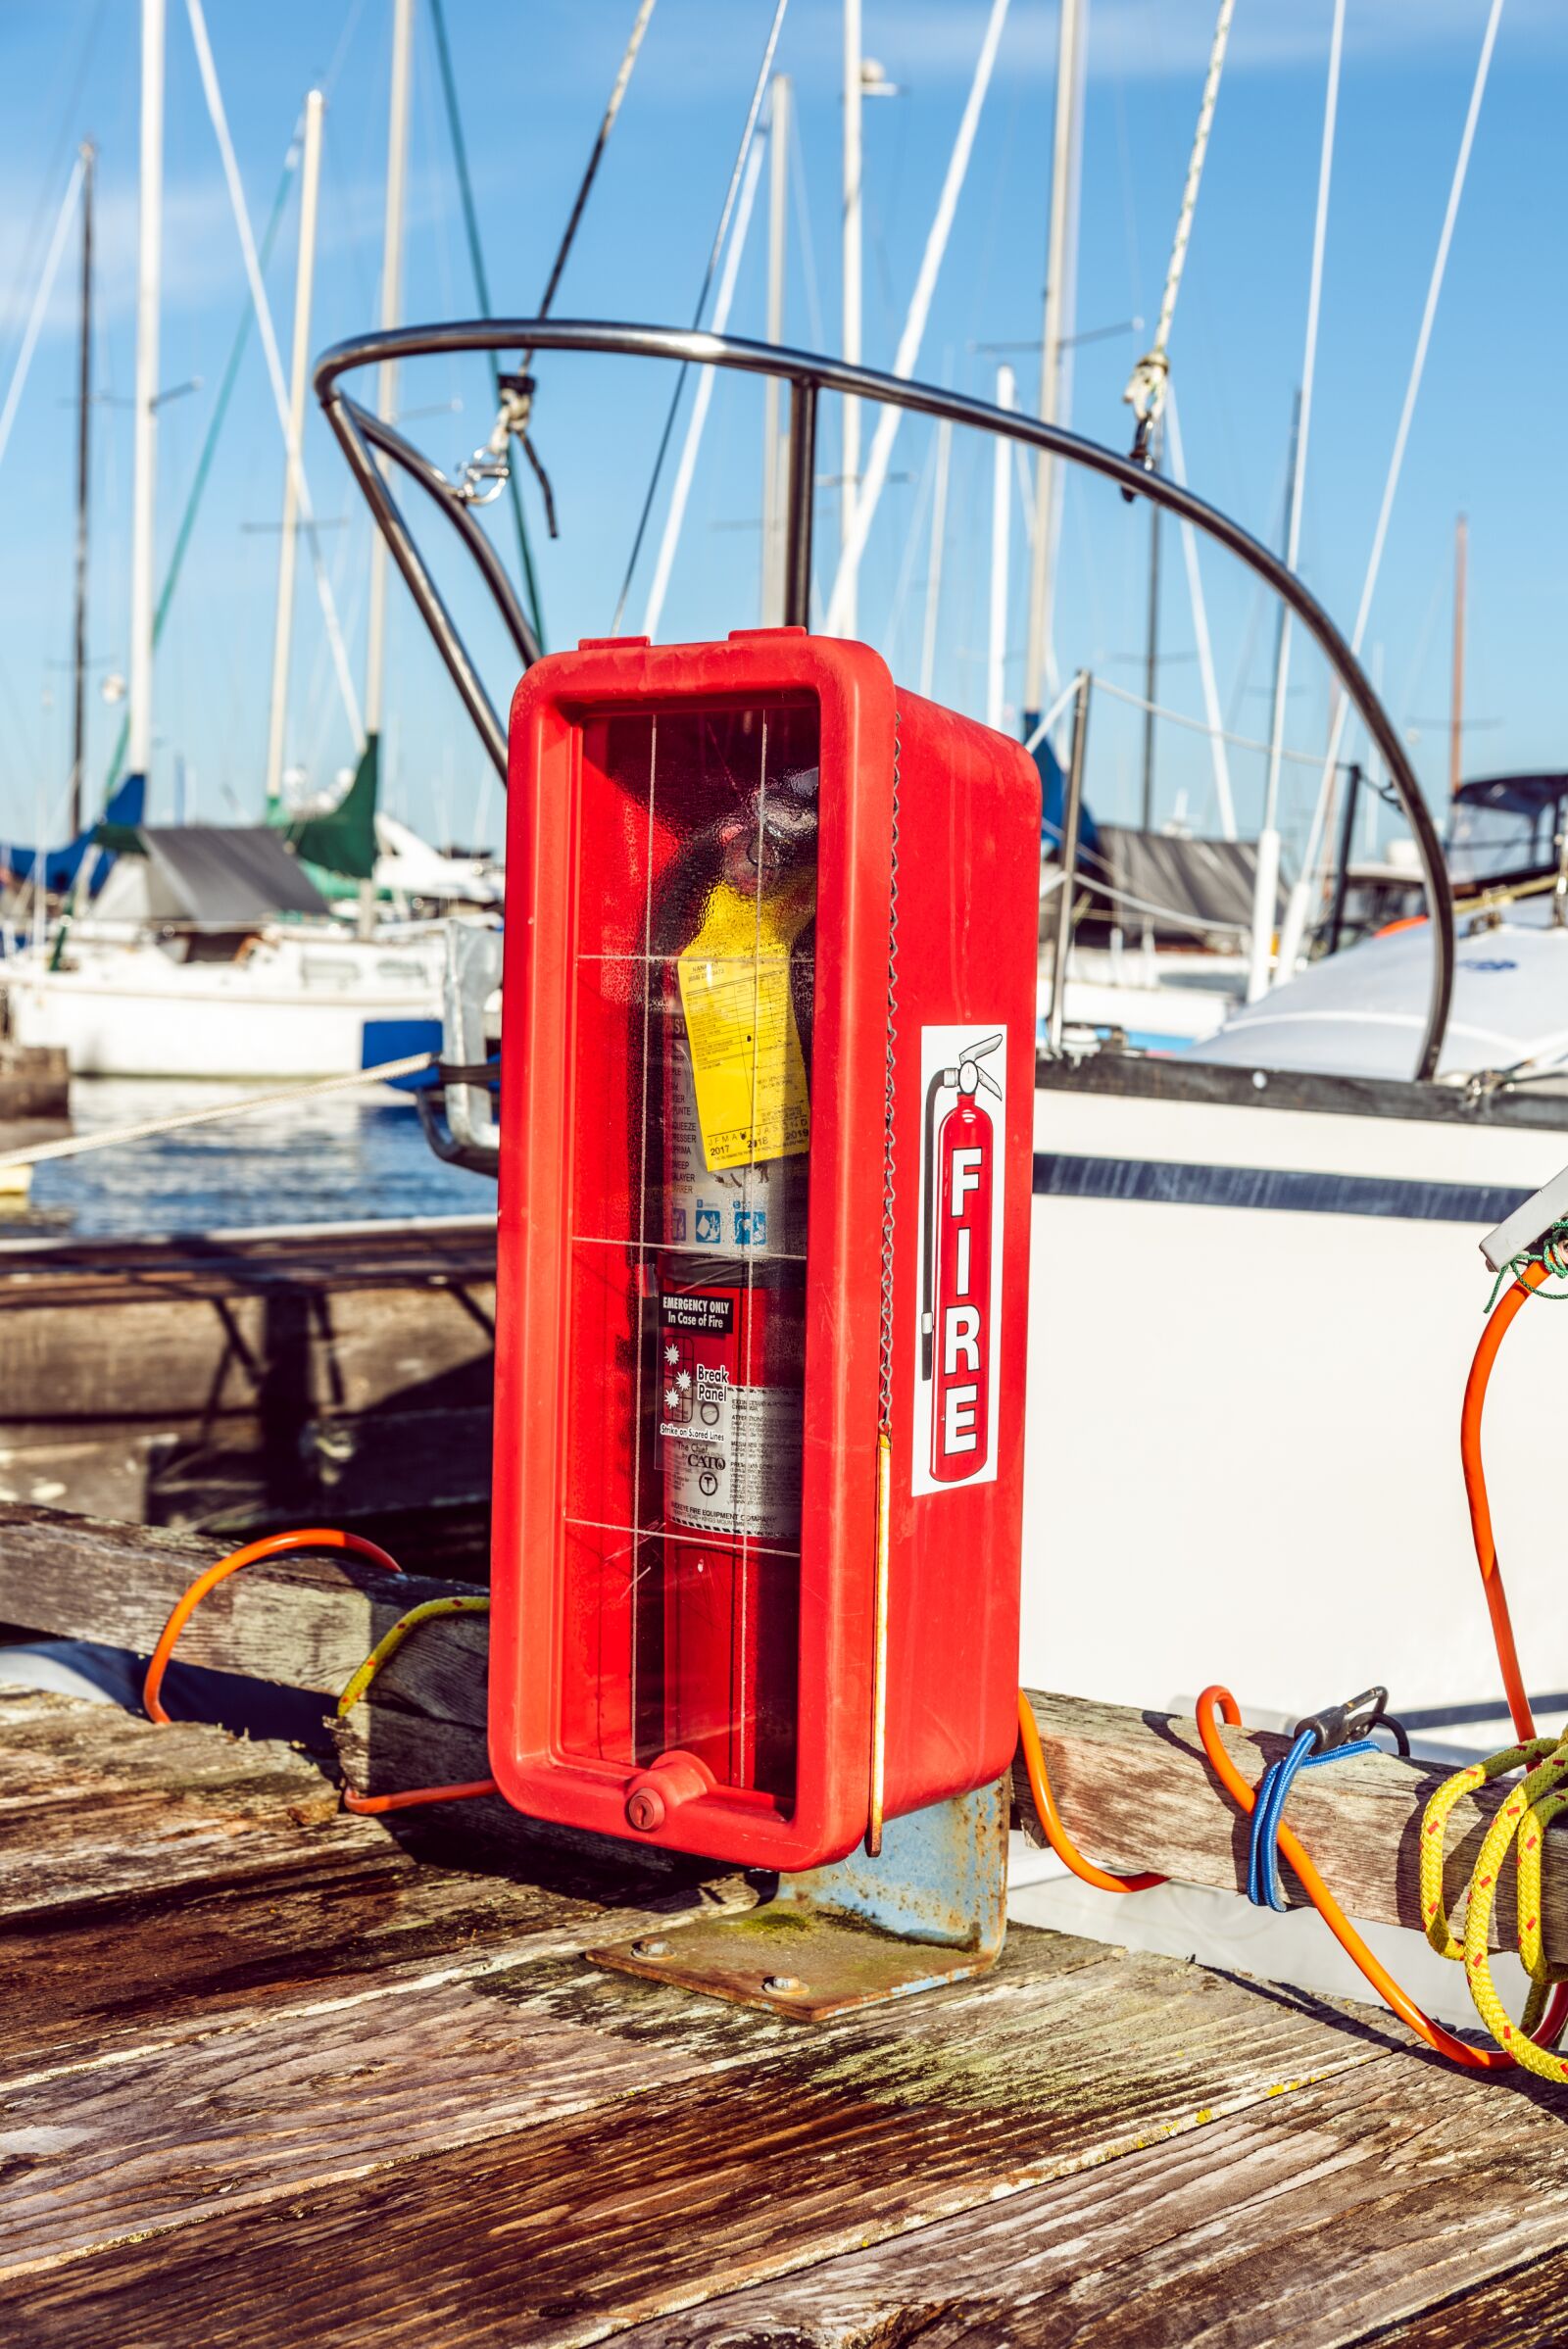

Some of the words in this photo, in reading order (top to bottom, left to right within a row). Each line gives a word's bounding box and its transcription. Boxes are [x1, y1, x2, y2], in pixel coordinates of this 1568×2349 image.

[710, 1145, 730, 1156] 2017
[662, 1297, 709, 1313] EMERGENCY
[710, 1300, 730, 1315] ONLY
[944, 1147, 982, 1456] FIRE
[667, 1310, 676, 1324] In
[677, 1311, 697, 1326] Case
[698, 1313, 708, 1327] of
[708, 1314, 723, 1328] Fire
[698, 1365, 728, 1384] Break
[699, 1384, 727, 1402] Panel
[662, 1424, 678, 1436] Strike
[710, 1431, 724, 1442] Lines
[676, 1441, 689, 1451] The
[688, 1453, 726, 1471] CATO
[689, 1506, 702, 1515] FIRE
[702, 1508, 739, 1521] EQUIPMENT
